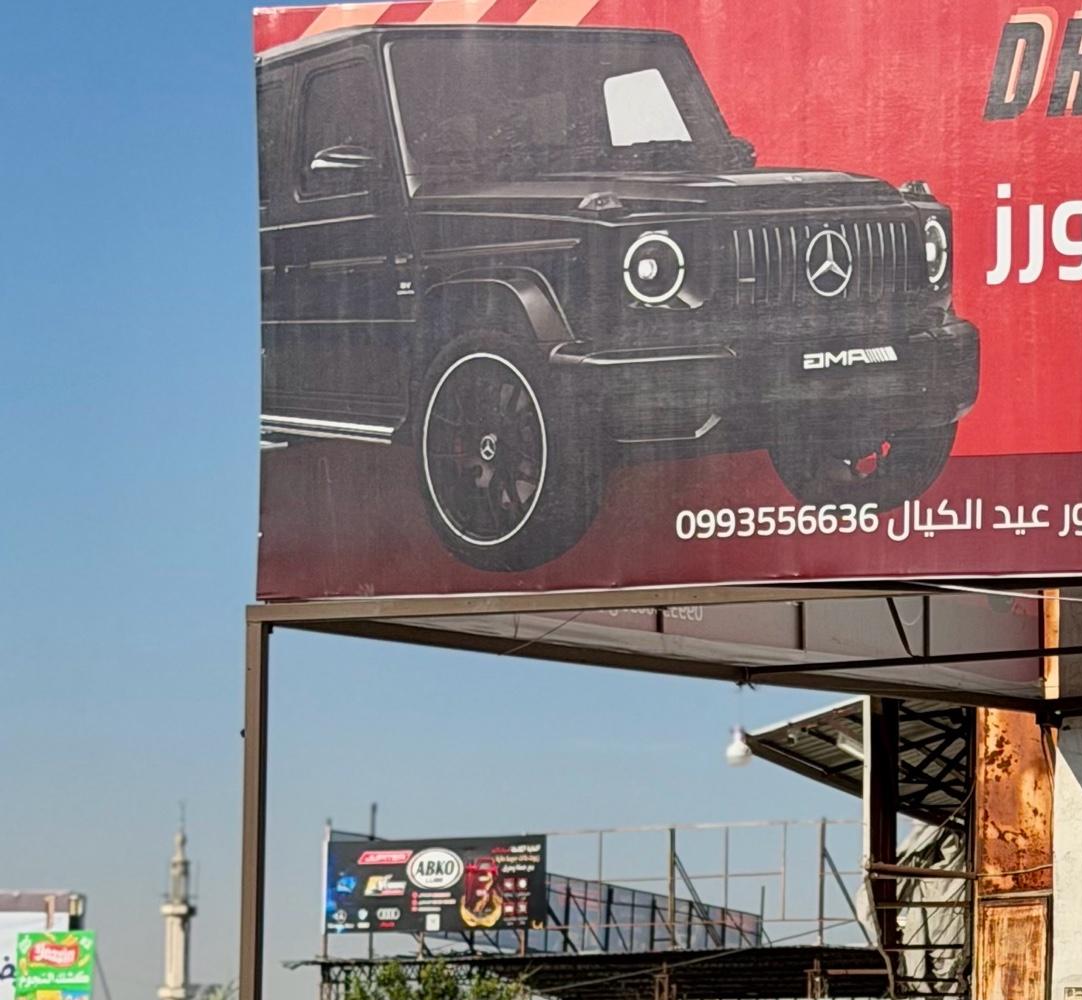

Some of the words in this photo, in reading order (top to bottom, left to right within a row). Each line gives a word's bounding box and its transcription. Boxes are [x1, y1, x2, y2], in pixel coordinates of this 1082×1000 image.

[675, 502, 879, 540] 0993556636
[887, 498, 983, 542] الكيال
[992, 503, 1050, 536] عيد
[415, 860, 455, 876] ABKO
